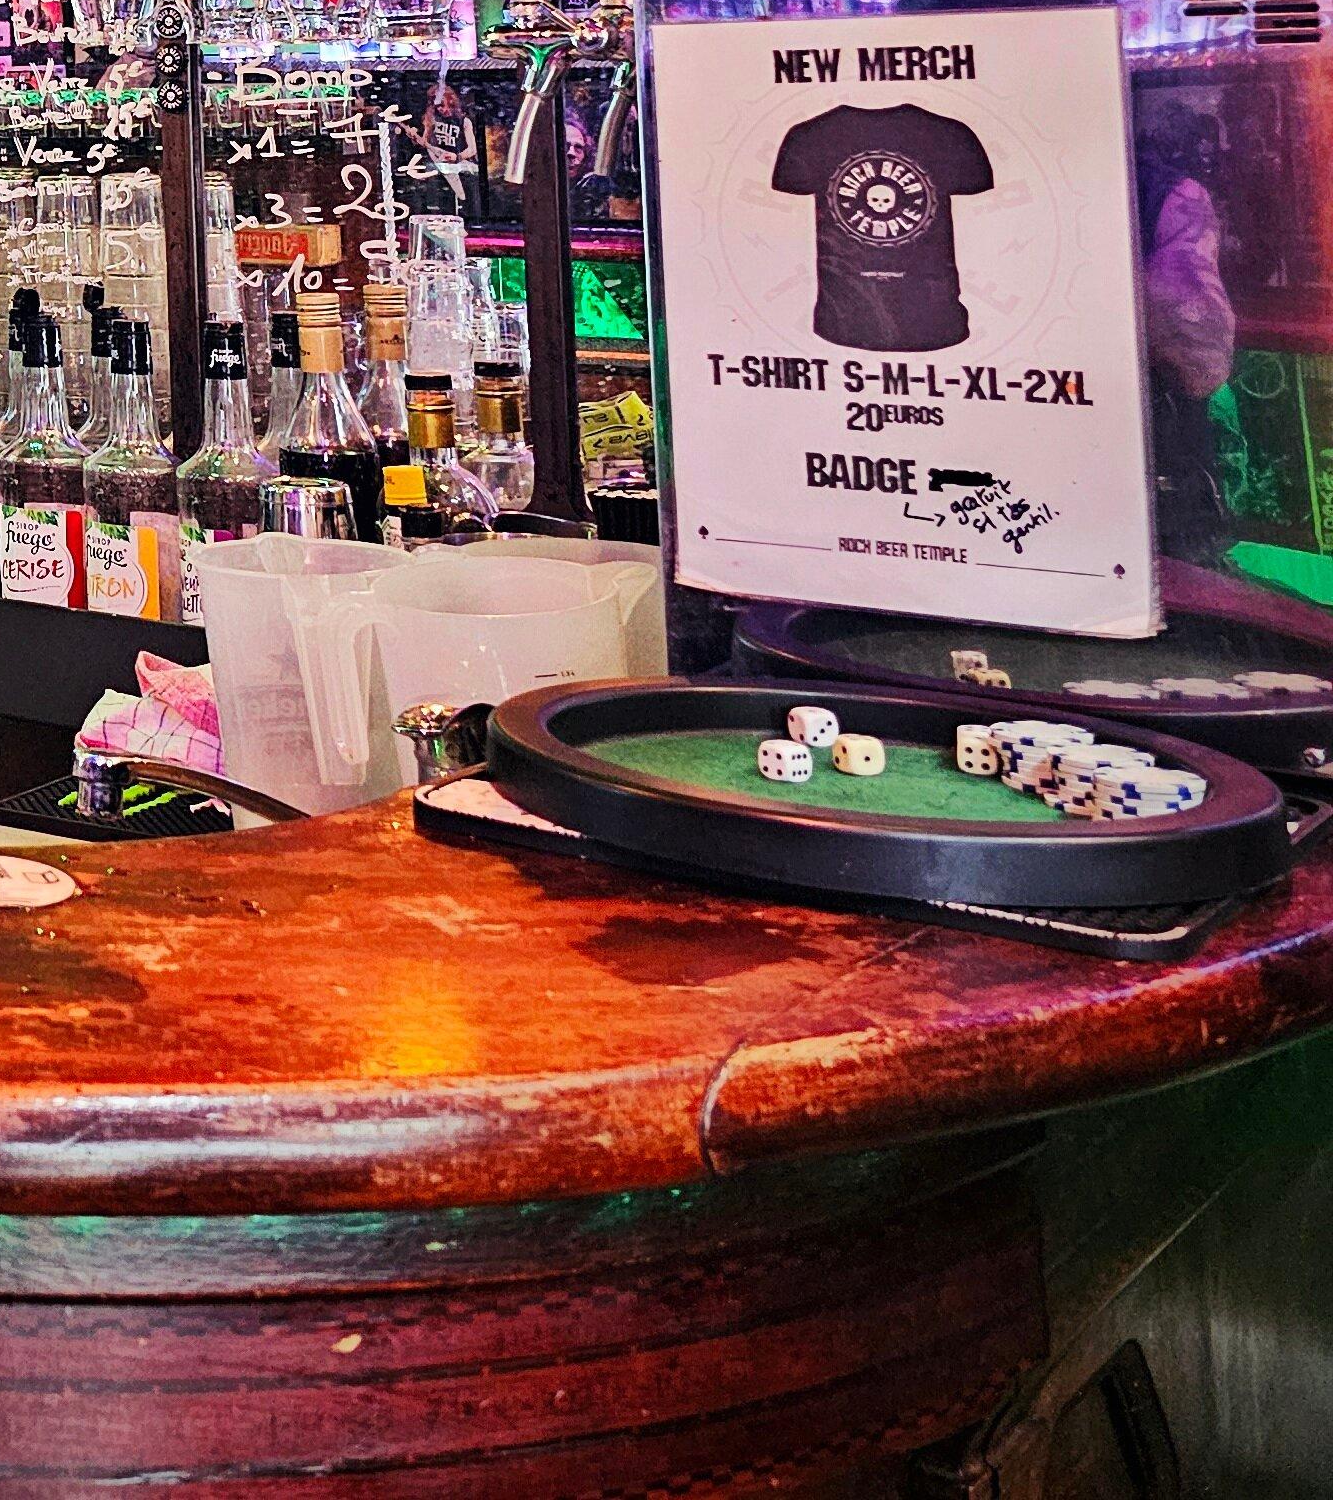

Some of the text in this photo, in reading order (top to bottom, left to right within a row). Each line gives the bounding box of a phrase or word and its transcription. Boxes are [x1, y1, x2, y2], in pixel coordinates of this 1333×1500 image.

[773, 45, 976, 84] NEW MERCH
[838, 160, 923, 198] ROCK BEER
[846, 204, 923, 238] TEMPLE
[708, 353, 1093, 406] T-SHIRT S-M-L-XL-2XL
[805, 452, 918, 495] BADGE
[6, 520, 55, 554] fuego
[16, 522, 39, 530] SIROP
[839, 537, 967, 564] ROCK BEER TEMPLE
[2, 559, 65, 580] CERISE
[90, 575, 137, 598] TRON
